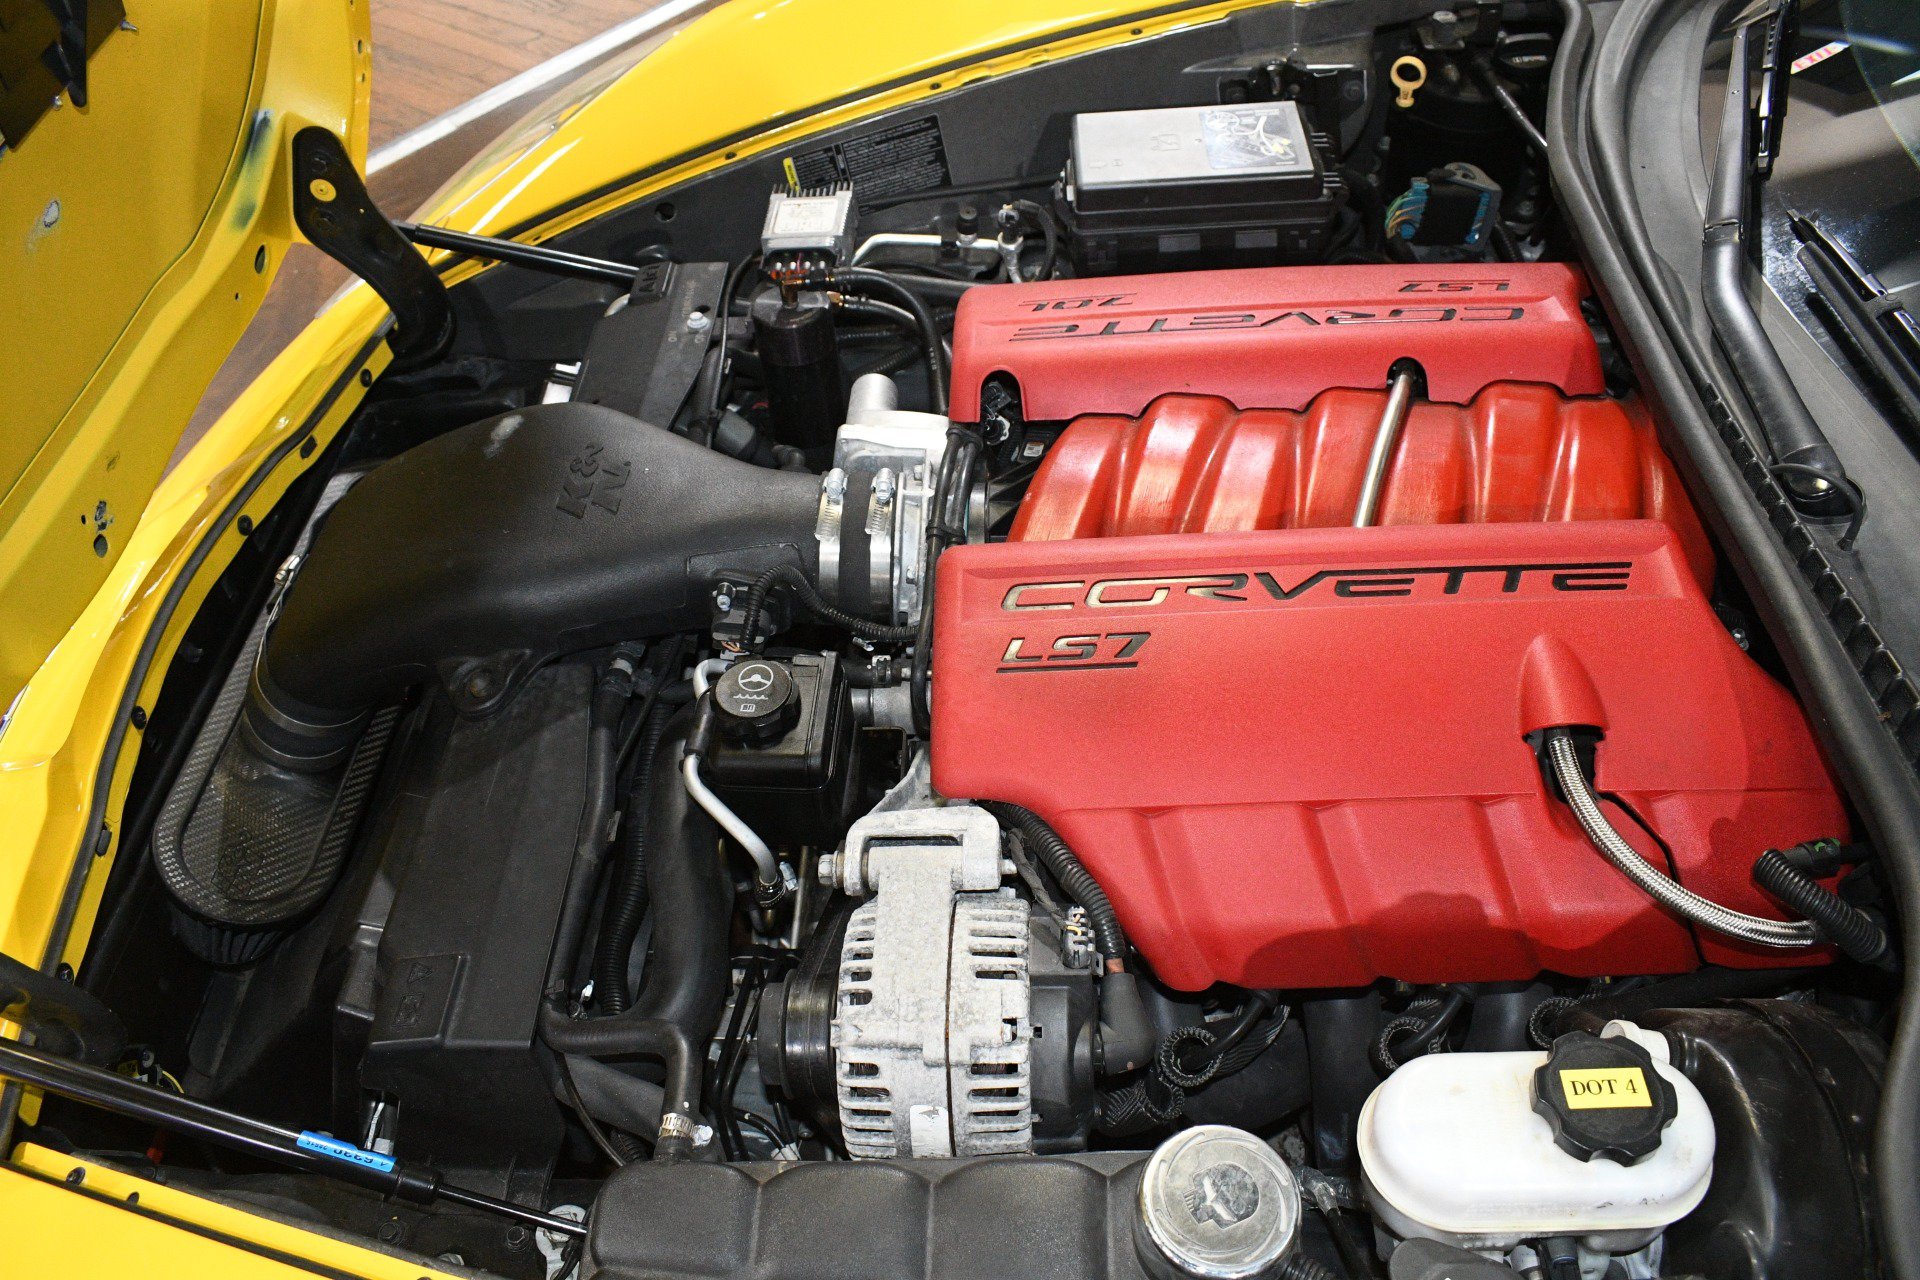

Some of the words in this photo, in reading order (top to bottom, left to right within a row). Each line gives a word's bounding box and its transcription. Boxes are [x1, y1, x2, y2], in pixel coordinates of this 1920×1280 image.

[1399, 280, 1510, 293] LS7
[1010, 307, 1524, 341] CORVETTE
[1001, 561, 1633, 611] CORVETTE
[1000, 631, 1152, 664] LS7
[1570, 1079, 1617, 1096] DOT
[1626, 1078, 1639, 1094] 4
